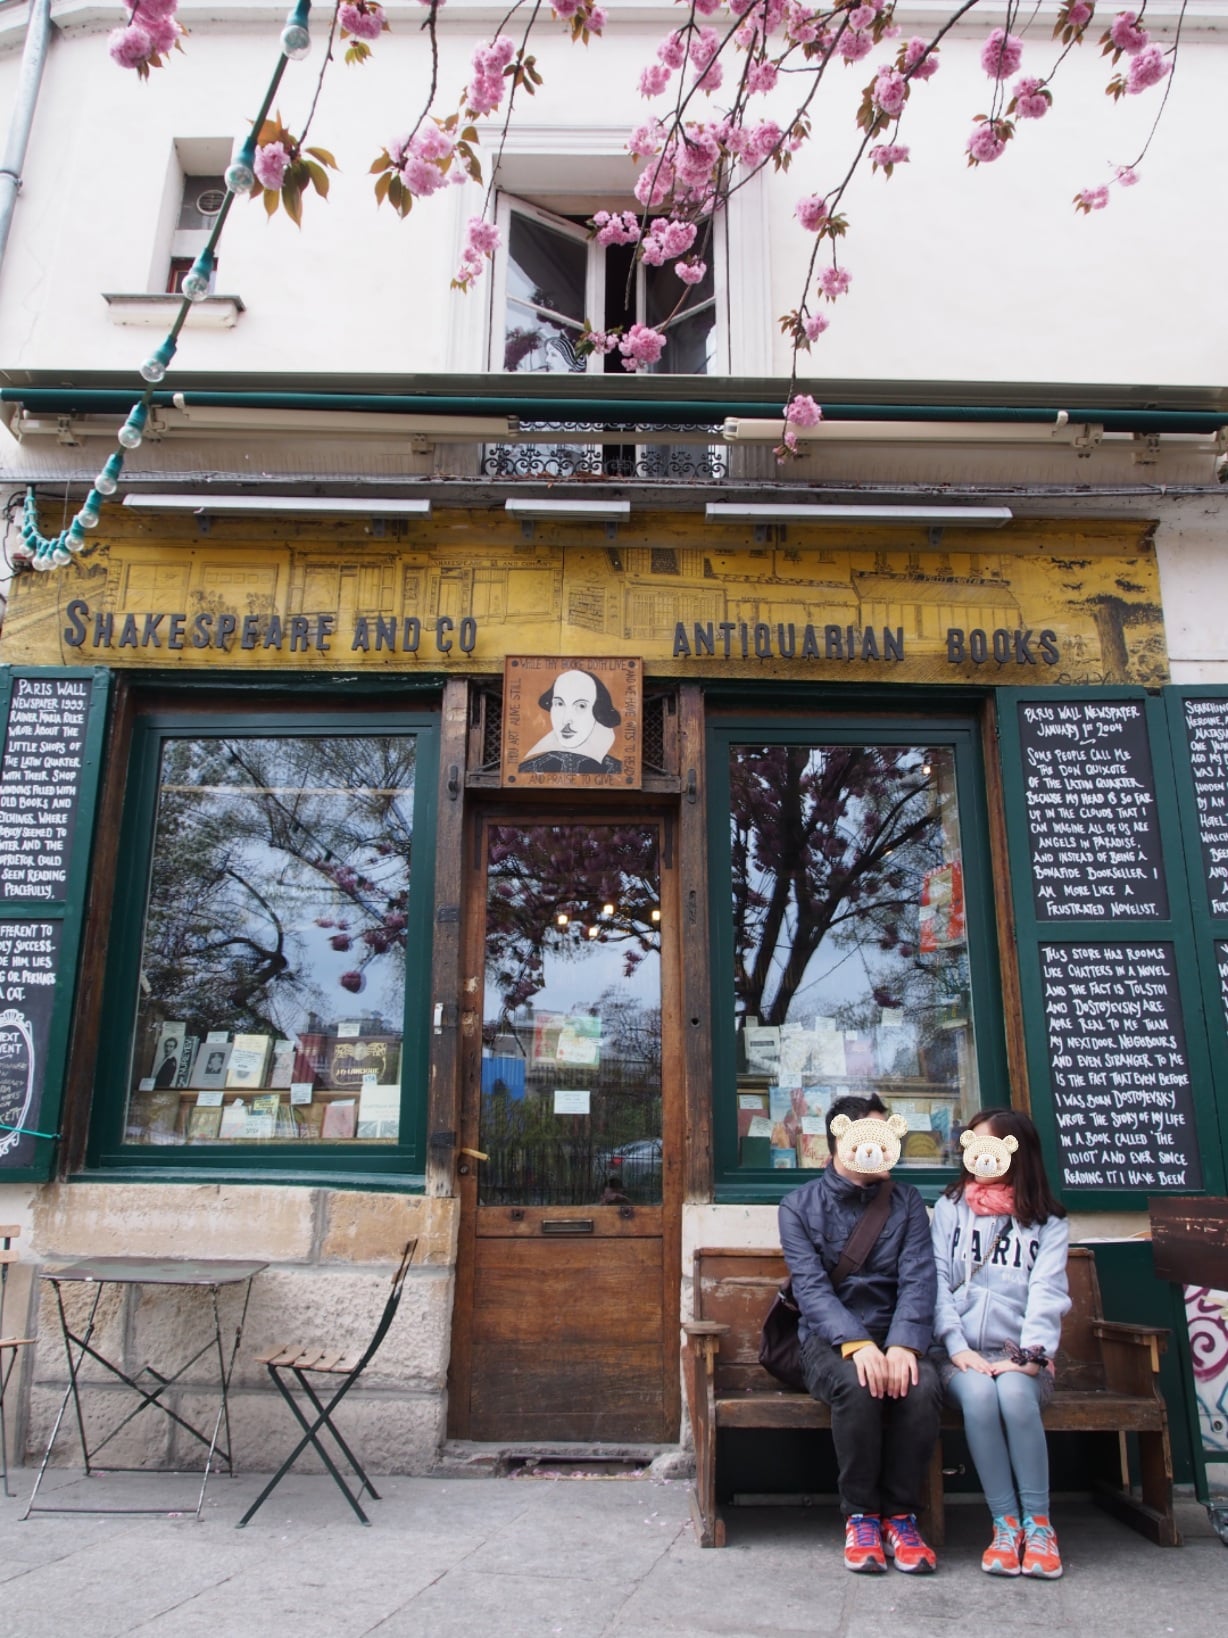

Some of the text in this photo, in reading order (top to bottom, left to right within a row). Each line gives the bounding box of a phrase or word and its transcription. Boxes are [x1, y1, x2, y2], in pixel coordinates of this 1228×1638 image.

[64, 600, 477, 654] SHAKESPEARE AND CO
[673, 622, 1060, 666] ANTIQUARIAN BOOKS
[18, 679, 87, 696] PARIS WALL
[11, 697, 59, 710] NEWSPAPER
[1024, 705, 1140, 723] PARIS WALL NEWSPAPER
[8, 724, 79, 737] WROTE ABOUT THE
[1037, 722, 1123, 740] JANUARY 2004
[8, 741, 82, 754] LITTLE SHOPS OF
[4, 755, 19, 767] THE
[44, 757, 82, 769] QUARTER
[1027, 747, 1132, 766] SOME PEOPLE CALL ME
[52, 769, 77, 782] SHOP
[1037, 764, 1127, 776] THE DON QUIXOTE
[1193, 766, 1214, 777] WAS
[1028, 776, 1144, 790] OF THE LATIN QUARTER
[1, 797, 72, 809] OLD BOOKS AND
[1065, 792, 1153, 806] MY HEAD SO FAR
[1211, 797, 1225, 808] AN
[38, 812, 68, 824] WHERE
[1029, 807, 1138, 821] UP IN THE CLOUDS THAT
[1200, 813, 1227, 827] HOTEL
[56, 827, 67, 838] TO
[1031, 822, 1149, 835] CAN IMAGINE ALL OF US ARE
[22, 840, 63, 851] AND THE
[1038, 836, 1142, 850] ANGELS IN PARADISE.
[37, 855, 62, 867] COULD
[1033, 851, 1148, 864] AND INSTEAD OF BEING A
[1, 868, 66, 882] SEEN READING
[1033, 866, 1148, 880] BONAFIDE BOOKSELLER
[5, 883, 55, 899] PEACEFULLY.
[1037, 884, 1135, 898] AM MORE LIKE A
[1046, 901, 1160, 917] FRUSTRATED NOVELIST.
[40, 925, 53, 937] TO
[12, 956, 52, 968] HIM LIES
[1041, 947, 1166, 963] THIS STORE HAS ROOMS
[7, 970, 20, 983] OR
[1043, 965, 1171, 978] LIKE IN A NOVEL
[6, 987, 26, 1001] CAT.
[1045, 980, 1168, 997] AND THE FACT IS TOLSTOI
[1046, 998, 1166, 1018] AND DOSTOYEVSKY ARE
[1049, 1017, 1169, 1033] MORE REAL TO ME THAN
[1050, 1034, 1178, 1055] MY NEIGHBOURS
[1052, 1052, 1185, 1068] AND EVEN STRANGER TO ME
[1055, 1071, 1190, 1087] IS THE FACT THAT EVEN BEFORE
[1062, 1090, 1177, 1109] WAS BORN DOSTOYEVSKY
[1055, 1111, 1186, 1131] WROTE THE STORY OF MY LIFE
[1060, 1131, 1148, 1146] IN A BOOK CALLED
[1101, 1151, 1189, 1166] AND EVER SINCE
[1063, 1168, 1186, 1185] READING IT HAVE BEEN
[952, 1226, 1039, 1272] PARIS
